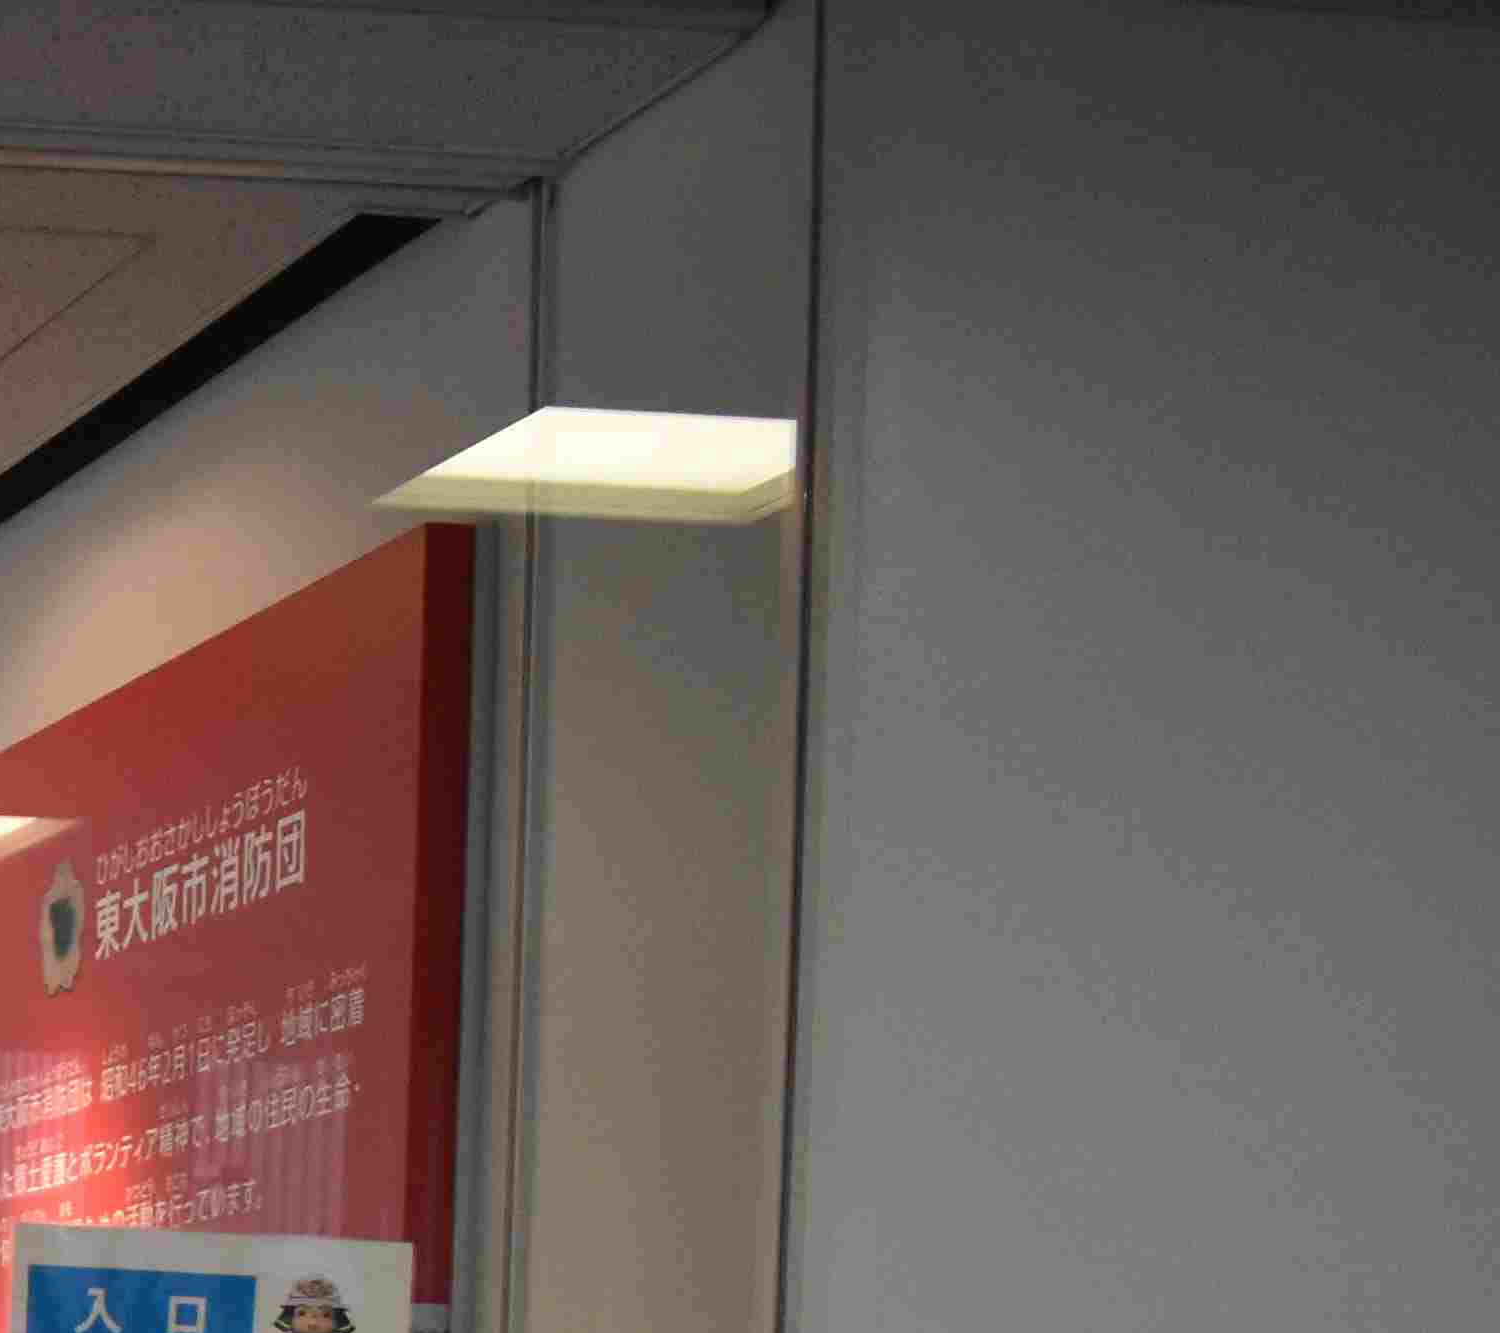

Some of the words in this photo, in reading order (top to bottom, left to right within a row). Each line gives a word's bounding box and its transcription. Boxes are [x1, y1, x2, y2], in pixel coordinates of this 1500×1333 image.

[94, 810, 305, 961] 東大阪市消防団
[95, 766, 308, 885] ひがしおおさかししょうぼうだん
